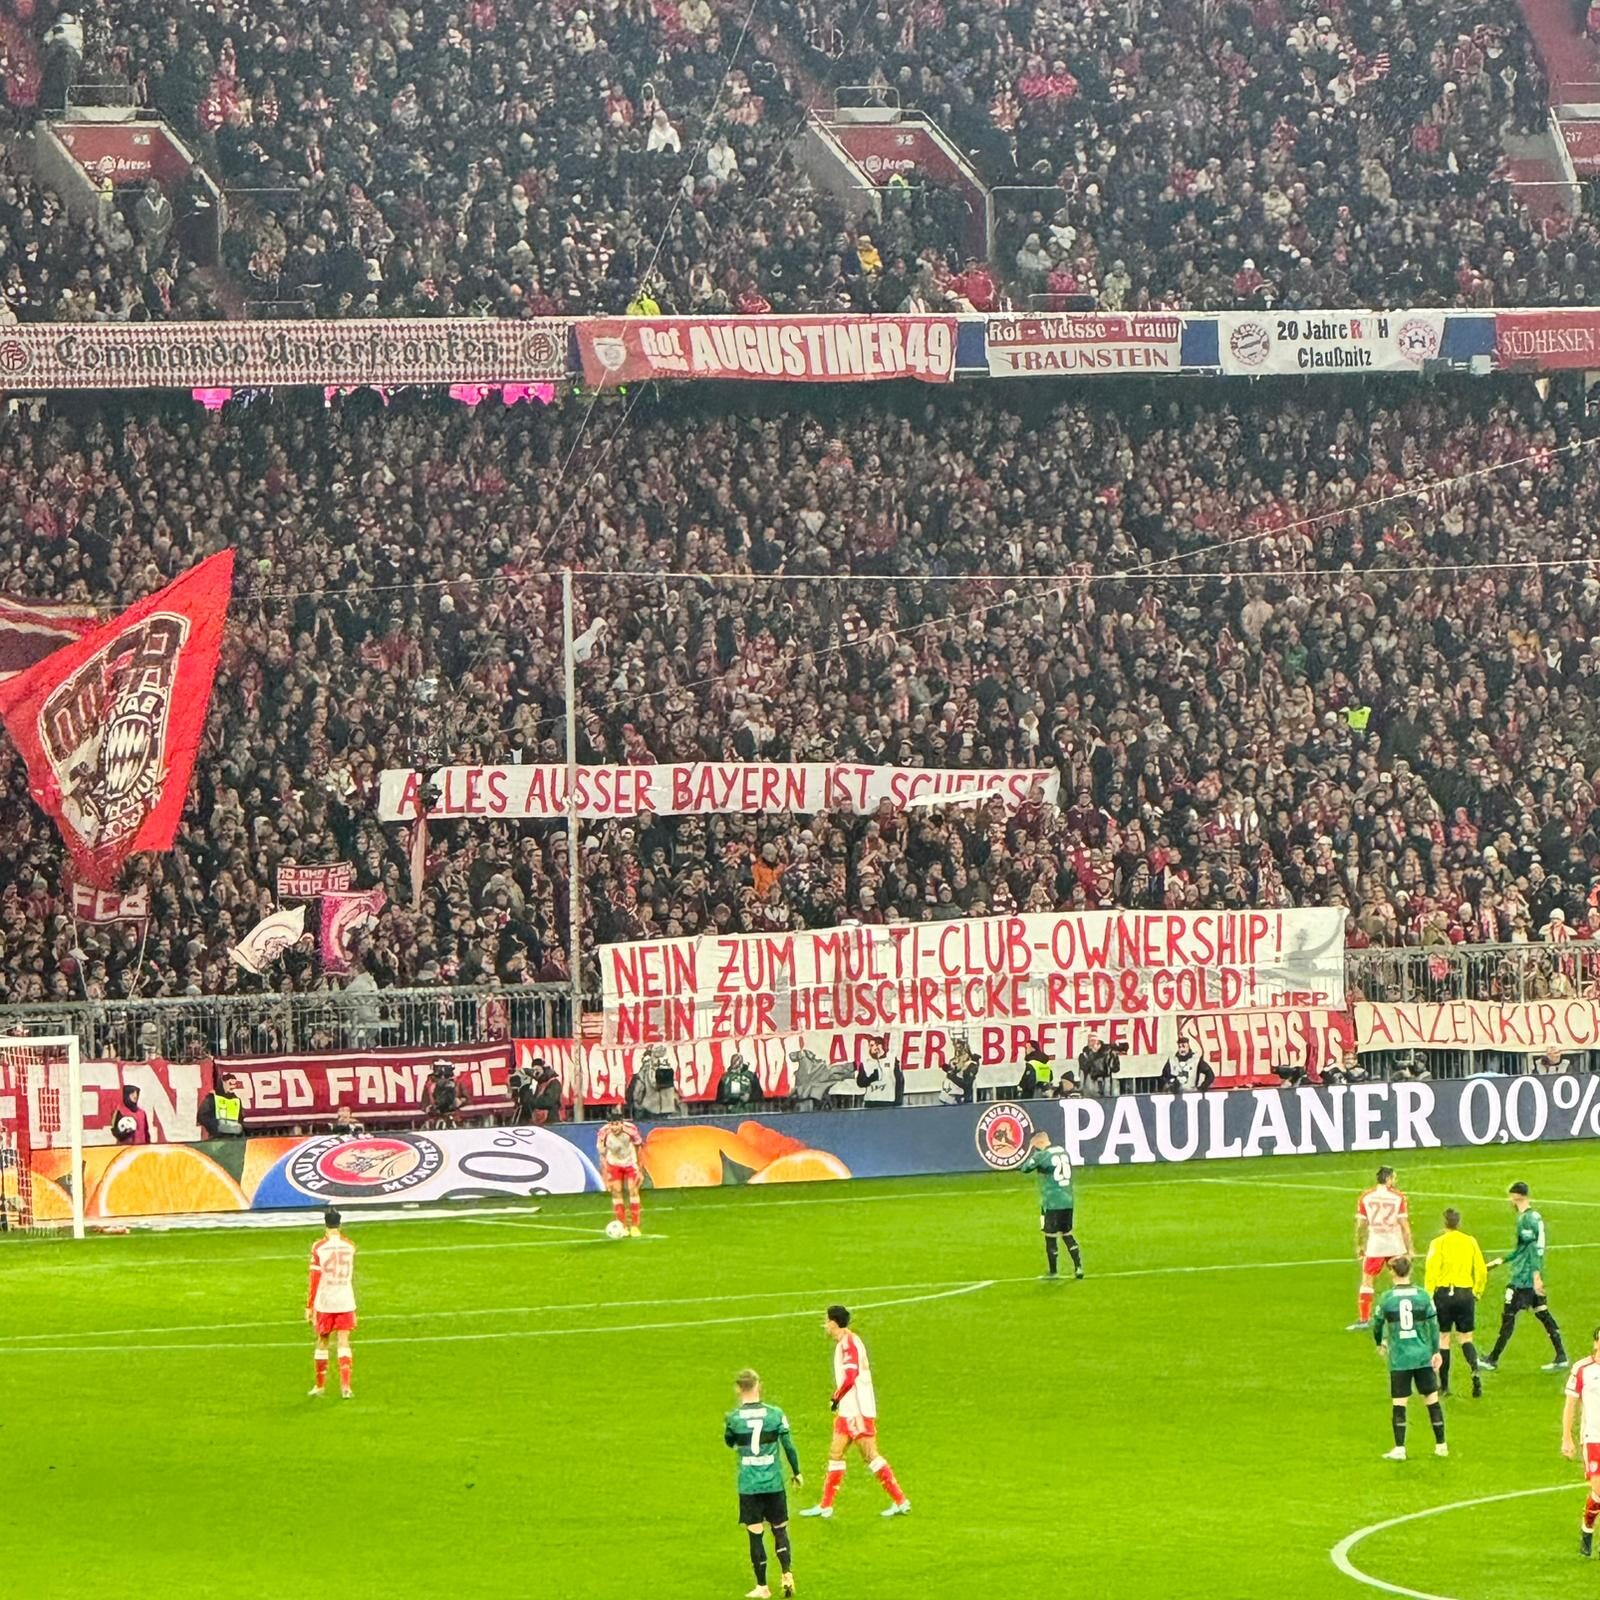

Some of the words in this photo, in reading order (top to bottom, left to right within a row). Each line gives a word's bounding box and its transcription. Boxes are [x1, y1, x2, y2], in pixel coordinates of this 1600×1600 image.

[639, 327, 684, 356] Rot
[1277, 320, 1299, 341] 20
[1302, 319, 1348, 340] Jahre
[1502, 326, 1596, 355] SÜDHESSEN
[1006, 347, 1169, 371] TRAUNSTEIN
[1297, 345, 1373, 369] Claußnitz
[524, 767, 657, 814] AUSSER
[671, 766, 806, 811] BAYERN
[824, 767, 876, 810] IST
[277, 880, 325, 895] STOP
[328, 876, 350, 890] US
[611, 941, 698, 999] NEIN
[717, 935, 797, 993] ZUM
[616, 996, 697, 1046] NEIN
[711, 992, 778, 1039] ZUR
[789, 972, 1032, 1031] HEUSCHRECKE
[1271, 991, 1329, 1007] MRP
[1059, 1081, 1441, 1166] PAULANER
[1458, 1074, 1600, 1146] 0,0%
[1368, 1201, 1396, 1227] 22
[1399, 1298, 1414, 1331] 6
[746, 1419, 764, 1456] 7
